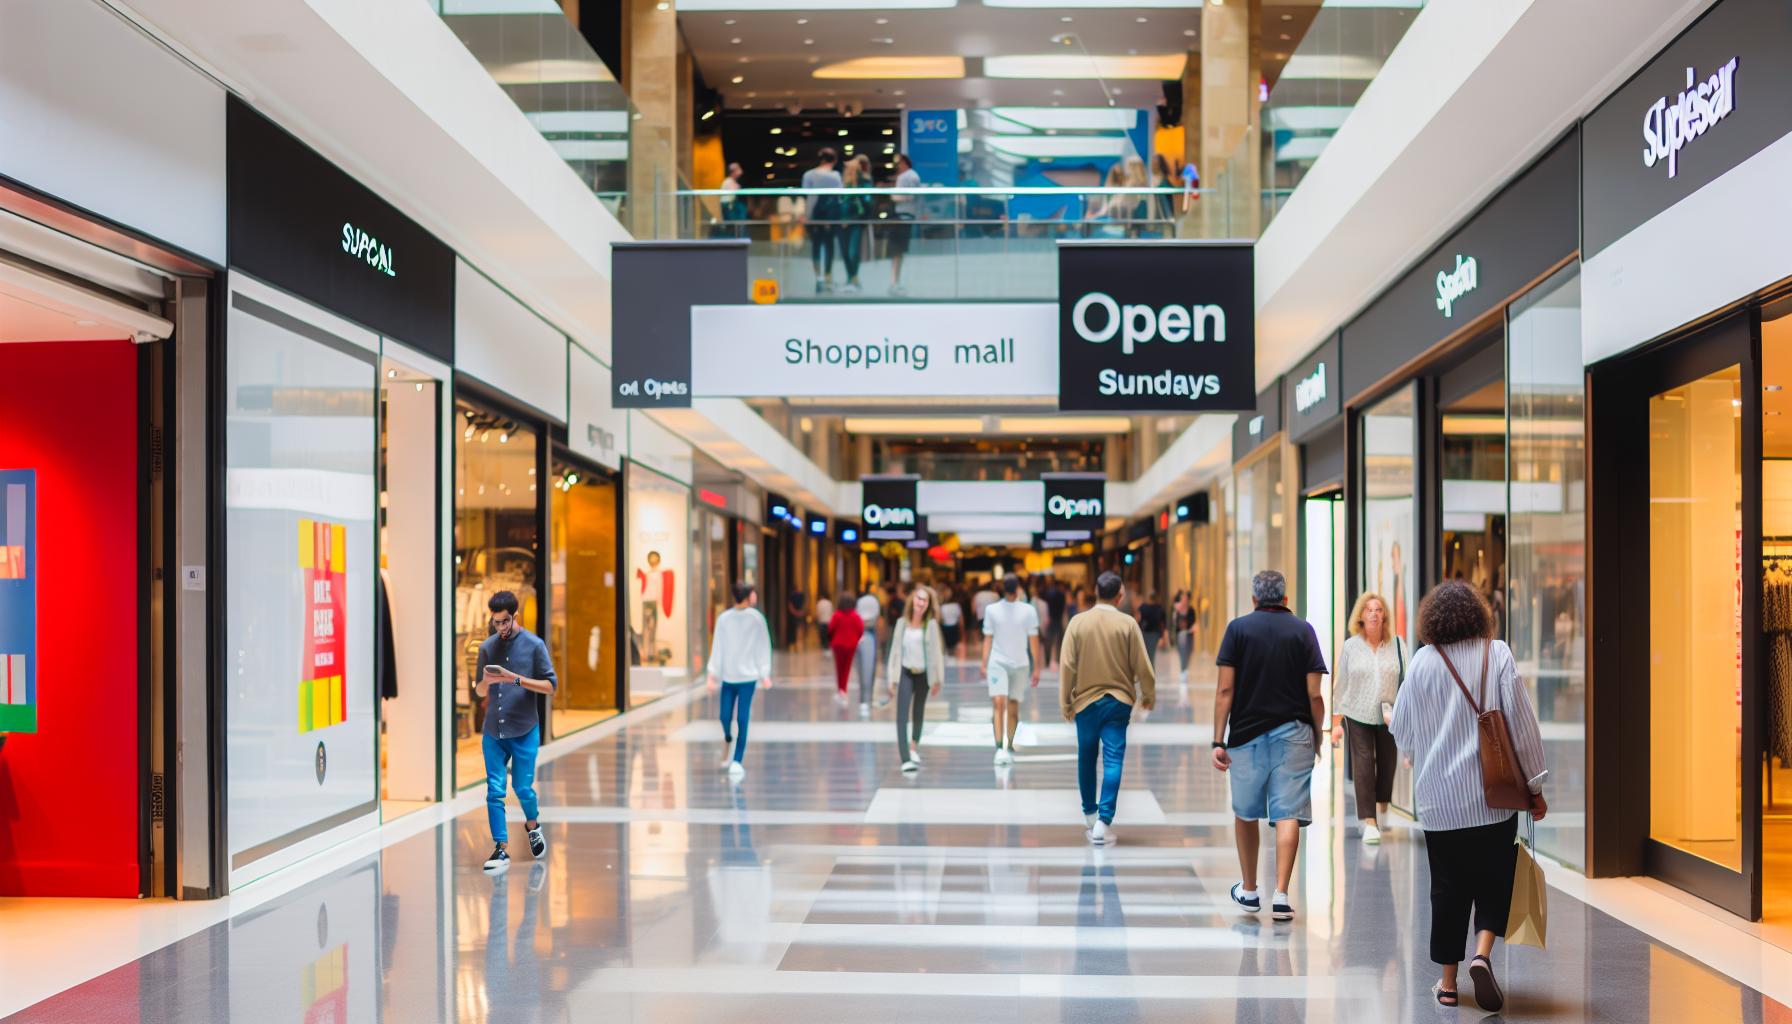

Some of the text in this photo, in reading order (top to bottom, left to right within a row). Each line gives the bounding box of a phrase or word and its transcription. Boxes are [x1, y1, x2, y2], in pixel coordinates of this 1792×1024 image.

[1072, 291, 1226, 355] Open
[784, 337, 1015, 370] Shopping mall
[1098, 368, 1221, 400] Sundays
